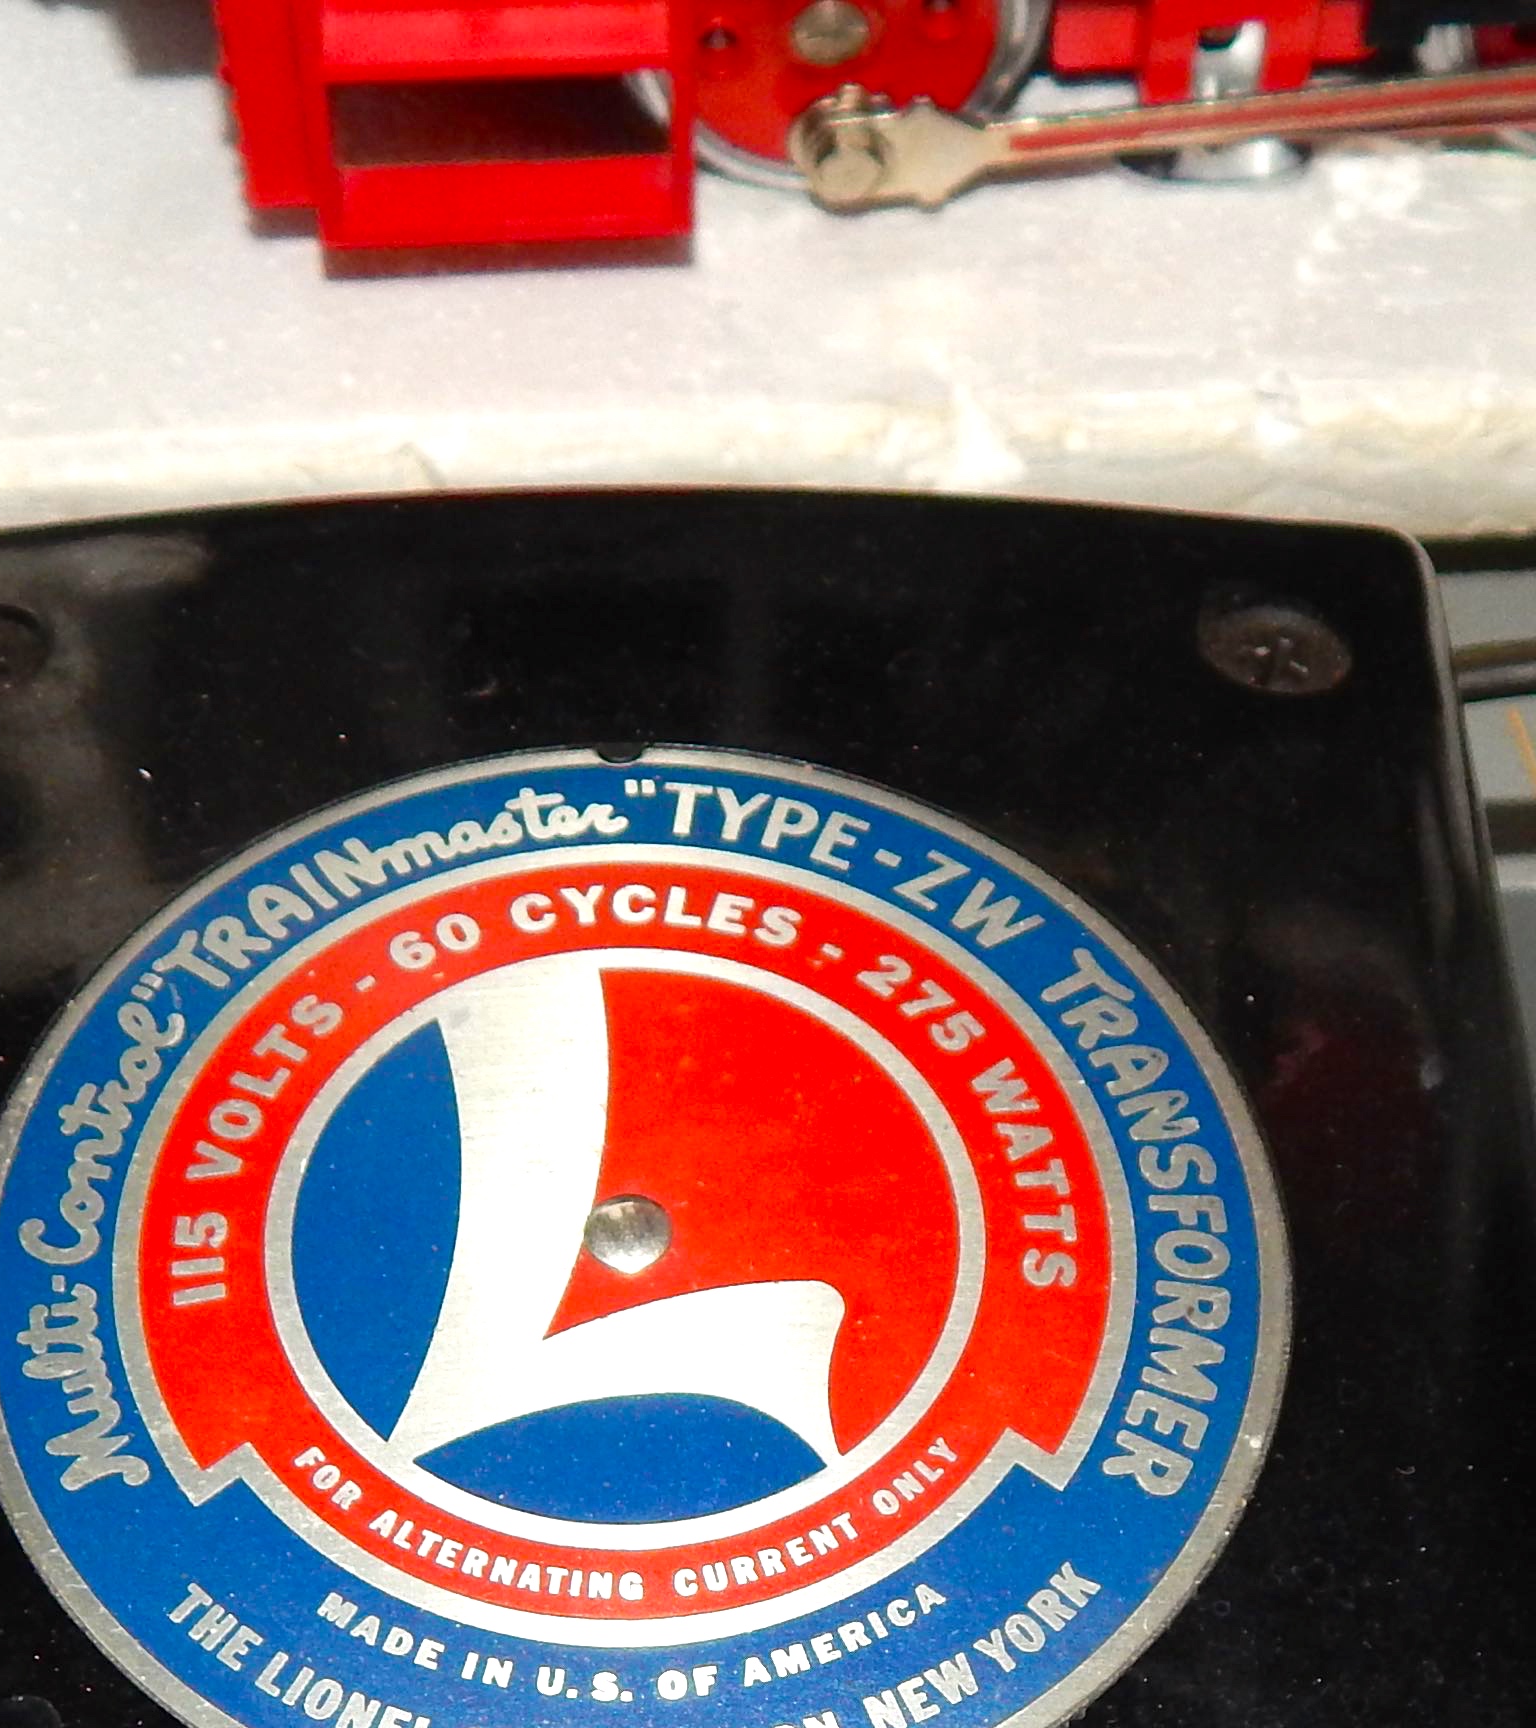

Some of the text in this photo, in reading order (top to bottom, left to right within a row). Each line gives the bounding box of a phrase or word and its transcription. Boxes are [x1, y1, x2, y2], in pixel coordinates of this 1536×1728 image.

[390, 912, 481, 971] 60
[510, 884, 802, 948] CYCLES
[855, 954, 986, 1052] 275
[186, 995, 344, 1182] VOLTS
[970, 1056, 1078, 1289] WATTS
[1040, 950, 1232, 1497] TRANSFORMER
[171, 1211, 229, 1307] 115
[293, 1435, 959, 1602] FOR ALTERNATING CURRENT ONLY
[166, 1581, 264, 1672] THE
[973, 1561, 1102, 1674] YORK
[317, 1592, 440, 1672] MADE
[462, 1651, 516, 1689] IN
[657, 1665, 719, 1699] OF
[741, 1583, 948, 1689] AMERICA
